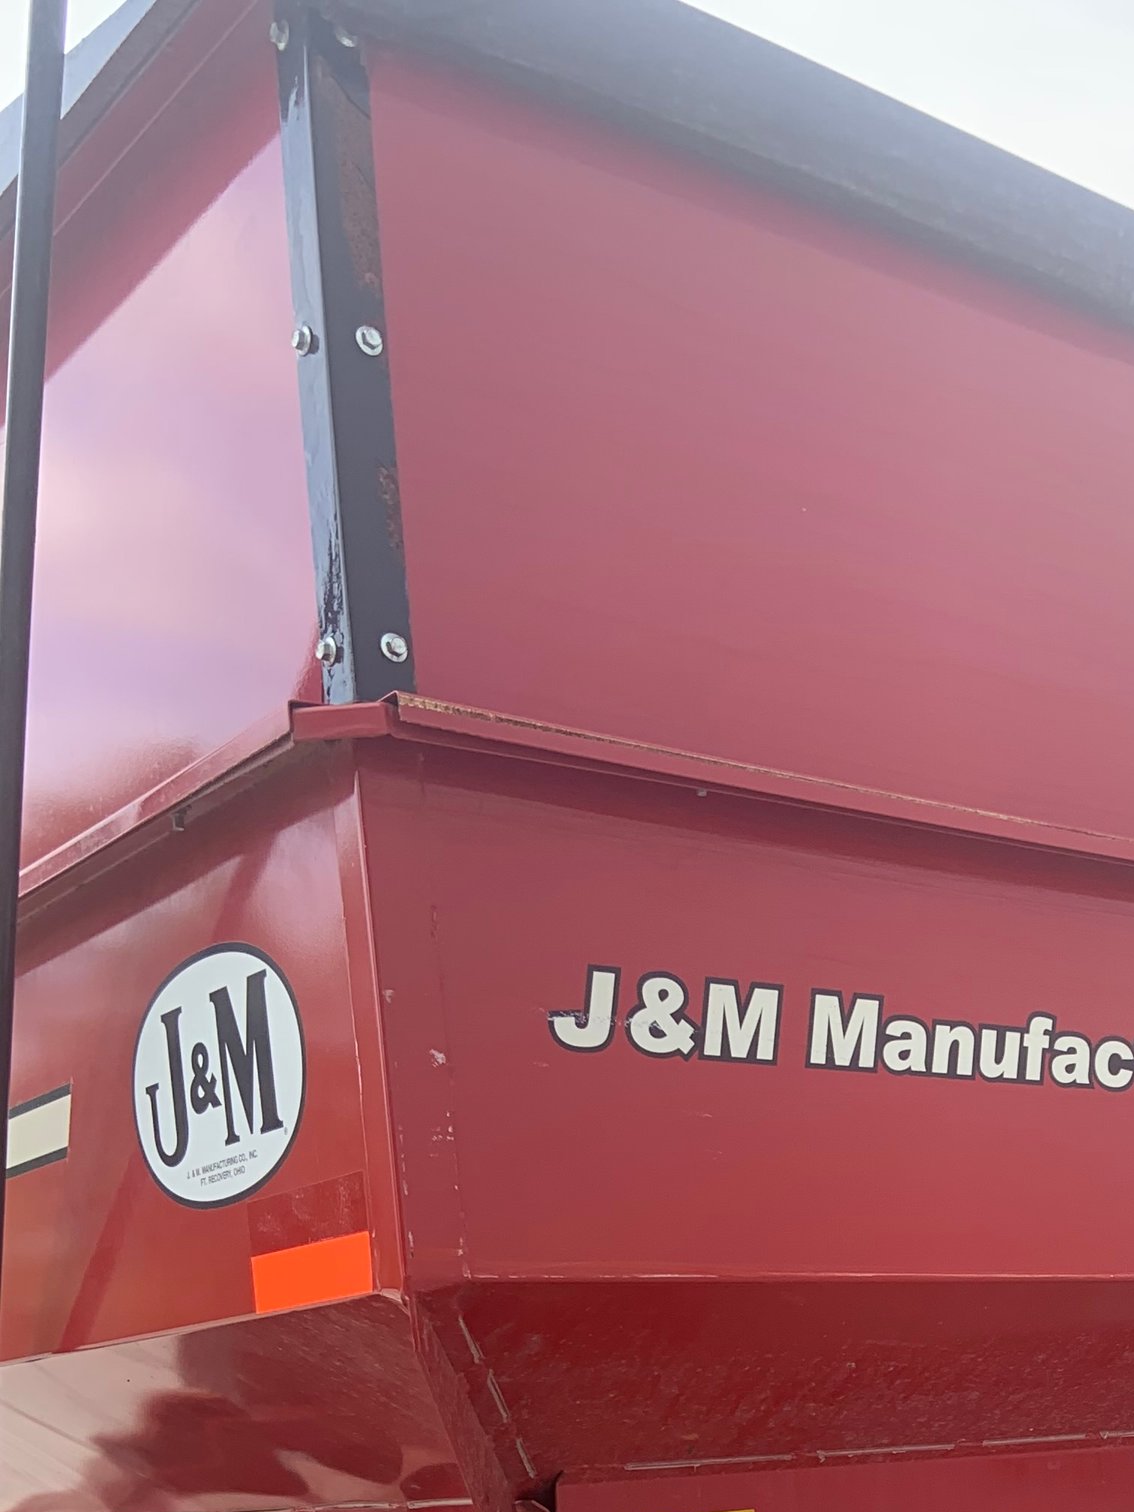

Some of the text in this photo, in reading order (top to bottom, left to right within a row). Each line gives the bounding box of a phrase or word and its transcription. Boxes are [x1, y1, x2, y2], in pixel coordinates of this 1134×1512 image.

[548, 964, 784, 1067] J&M
[145, 968, 284, 1168] J&M
[202, 1156, 239, 1174] MANUFACTURING
[233, 1166, 246, 1177] OHIO
